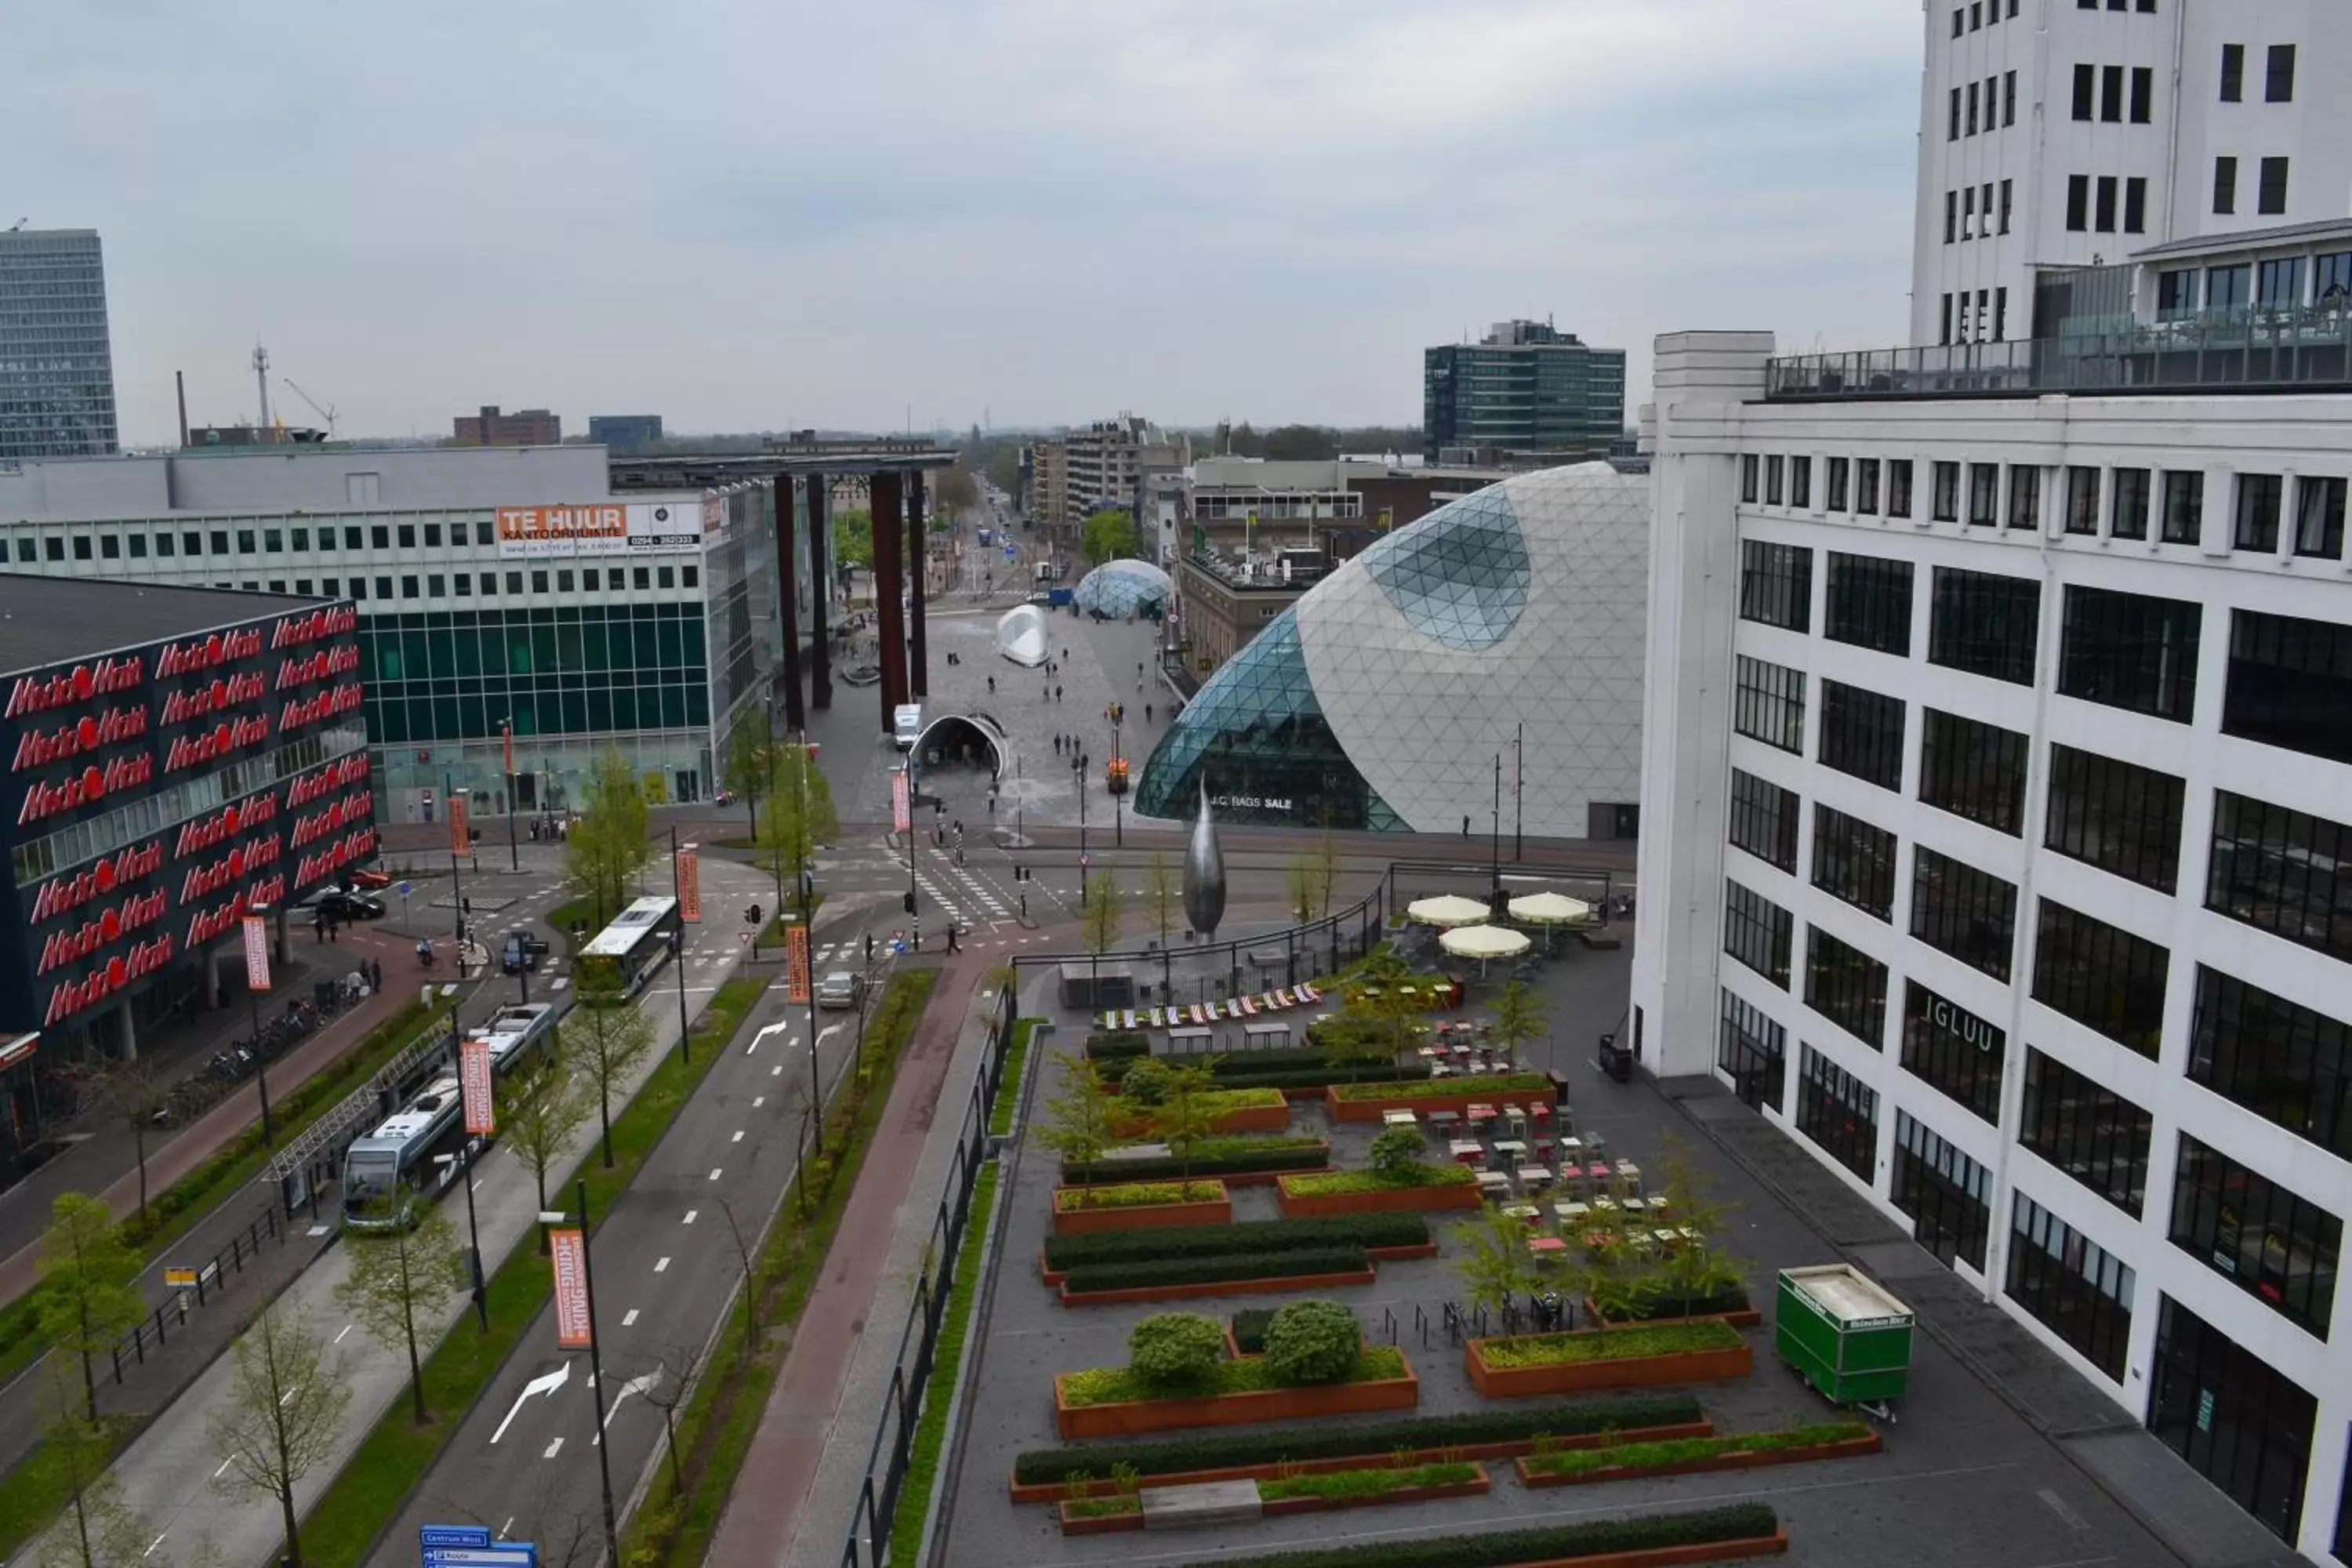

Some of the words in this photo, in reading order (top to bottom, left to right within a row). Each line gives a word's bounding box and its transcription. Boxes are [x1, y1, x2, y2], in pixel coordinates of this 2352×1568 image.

[503, 511, 537, 531] TE
[546, 509, 620, 529] HUUR
[1232, 795, 1261, 807] BAGS
[1265, 798, 1292, 809] SALE
[558, 1244, 574, 1287] KING
[571, 1288, 587, 1330] KING
